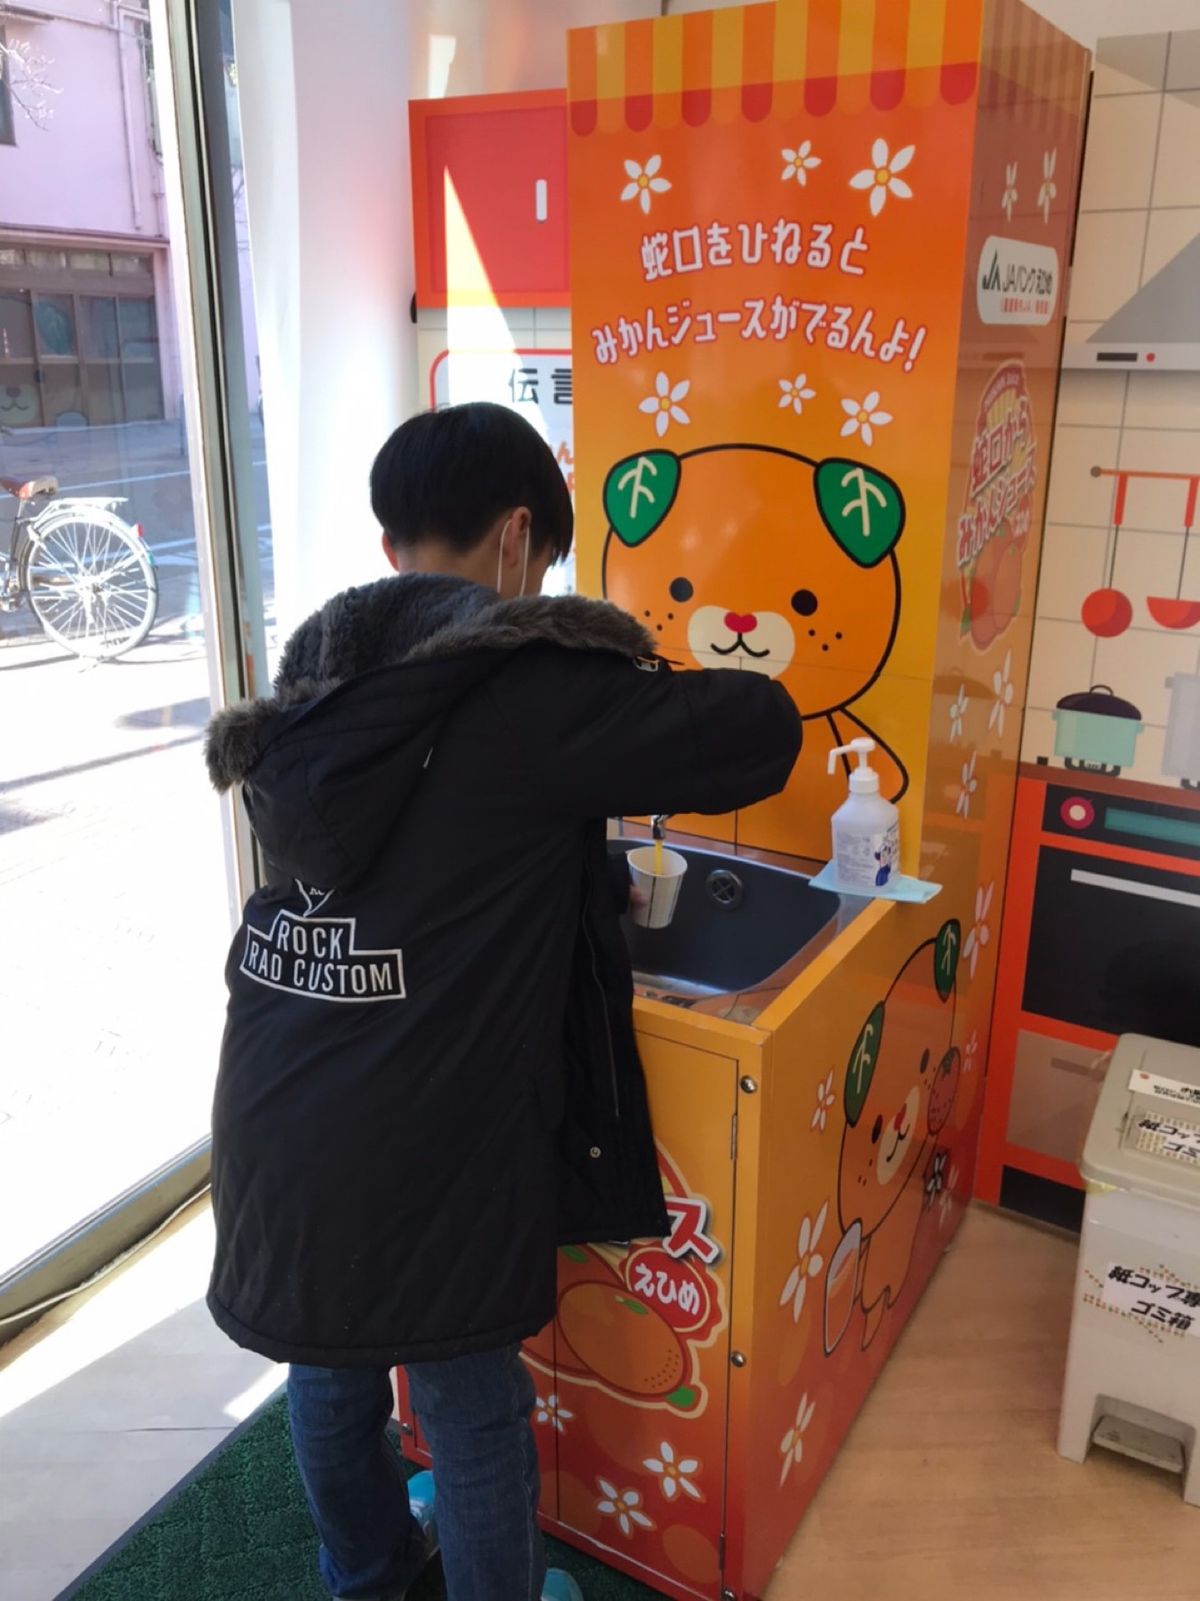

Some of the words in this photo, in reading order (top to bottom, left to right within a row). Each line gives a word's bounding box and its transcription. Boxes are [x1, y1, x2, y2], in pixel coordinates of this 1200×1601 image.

[640, 218, 869, 281] 蛇口をひねると
[591, 295, 927, 372] みかんジュースがでるんよ!
[276, 920, 343, 960] ROCK
[248, 940, 283, 982] RAD
[293, 958, 393, 995] CUSTOM
[633, 1262, 702, 1316] えひめ
[1130, 1299, 1196, 1331] ゴミ箱
